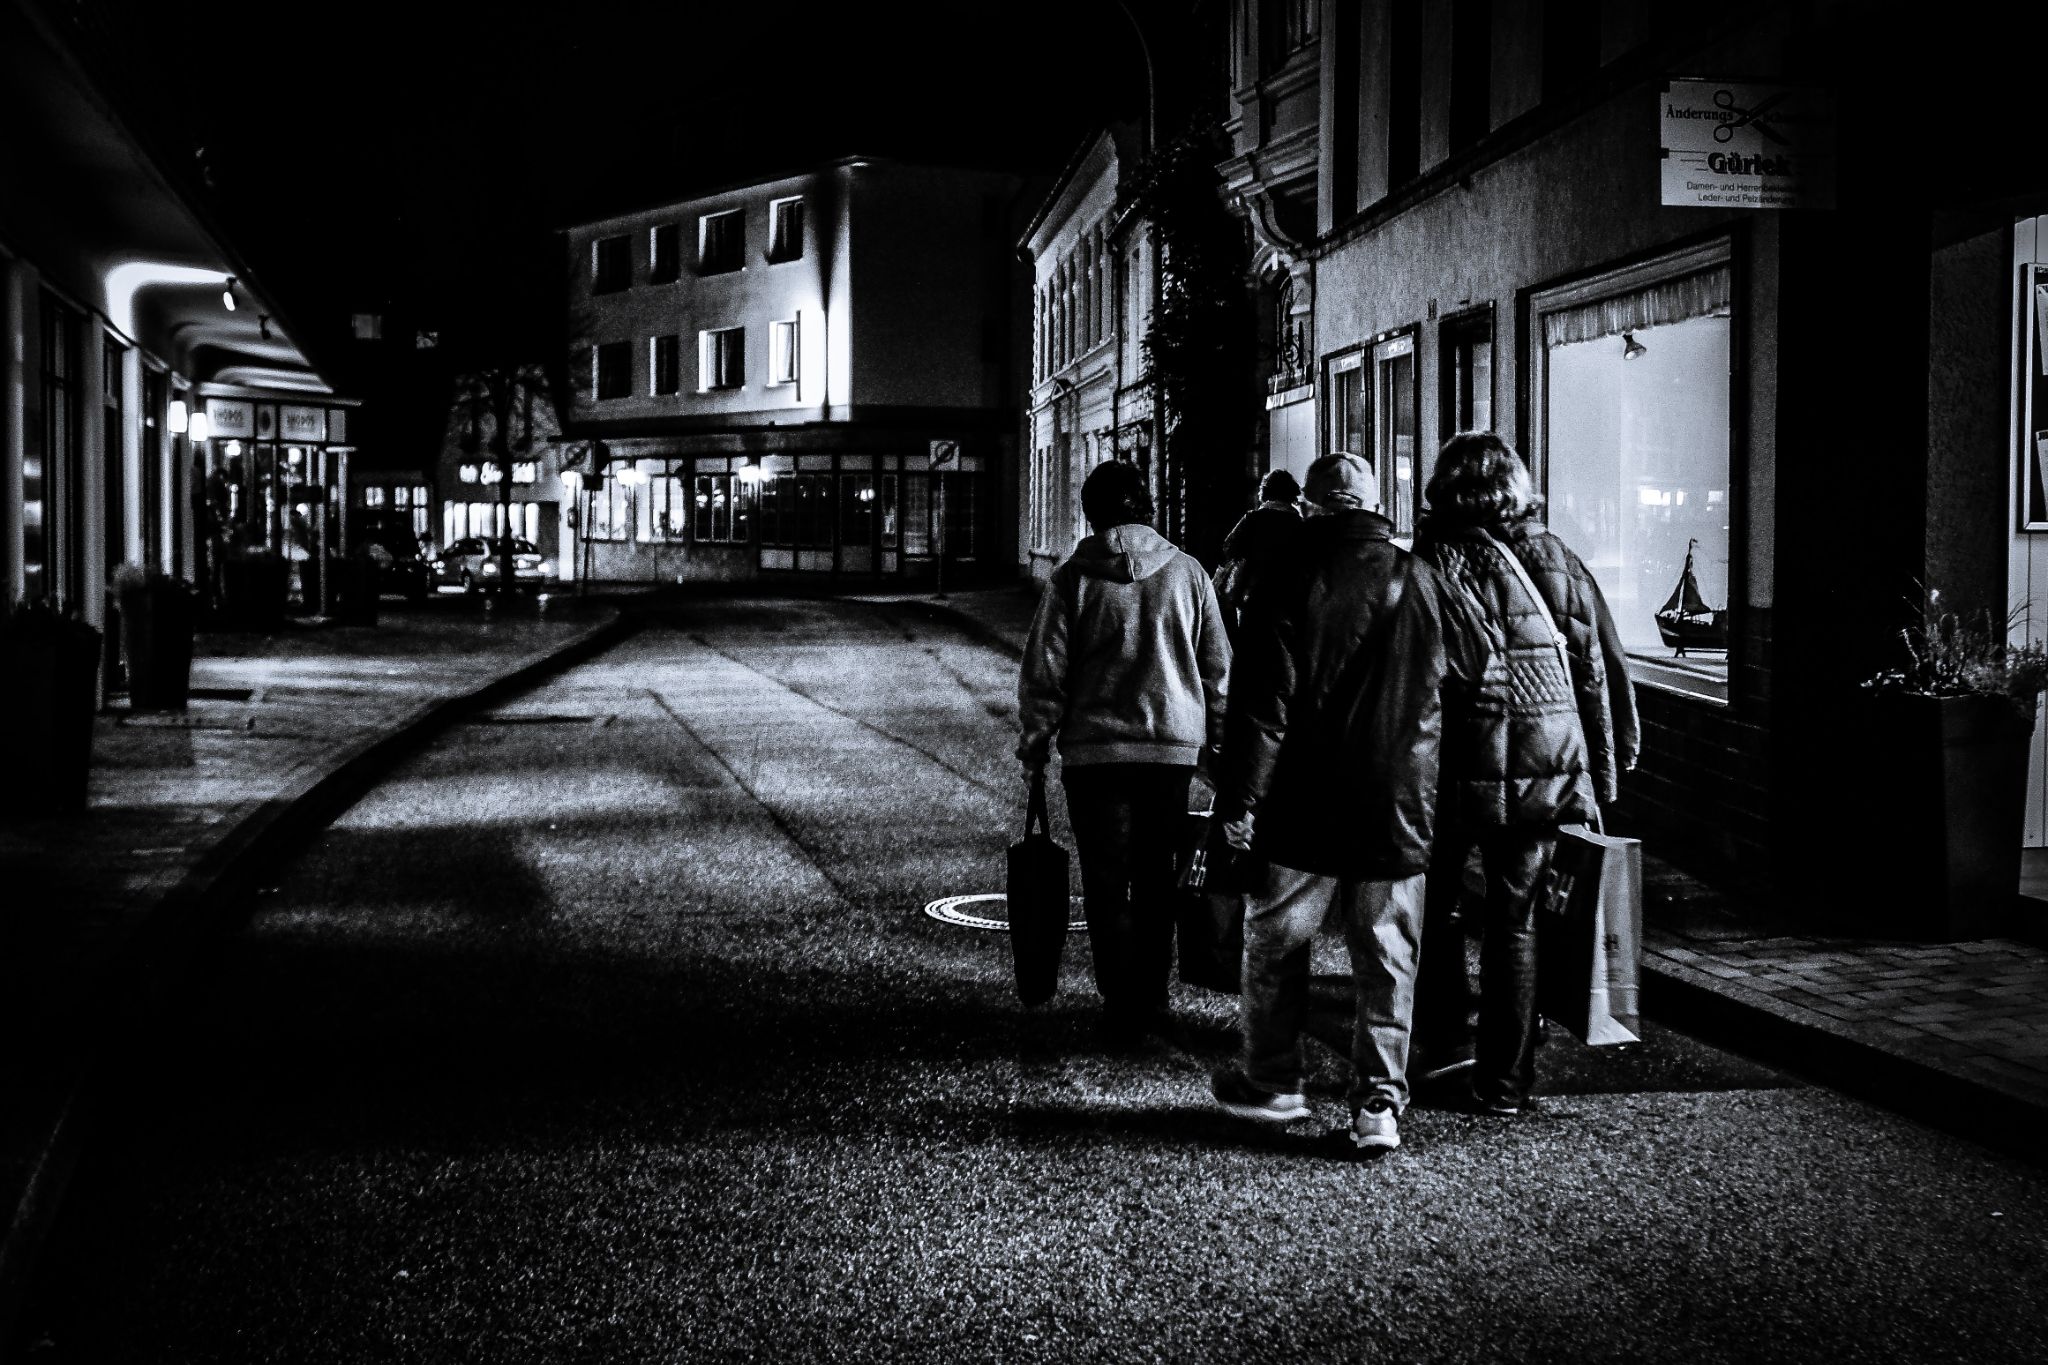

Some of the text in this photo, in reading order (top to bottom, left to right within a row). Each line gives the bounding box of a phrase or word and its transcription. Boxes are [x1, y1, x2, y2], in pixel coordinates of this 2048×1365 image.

[1666, 104, 1733, 123] Änderungs
[1686, 181, 1807, 195] Damen- und Herrenbekleid
[1698, 193, 1724, 203] Leder-
[1725, 193, 1740, 203] und
